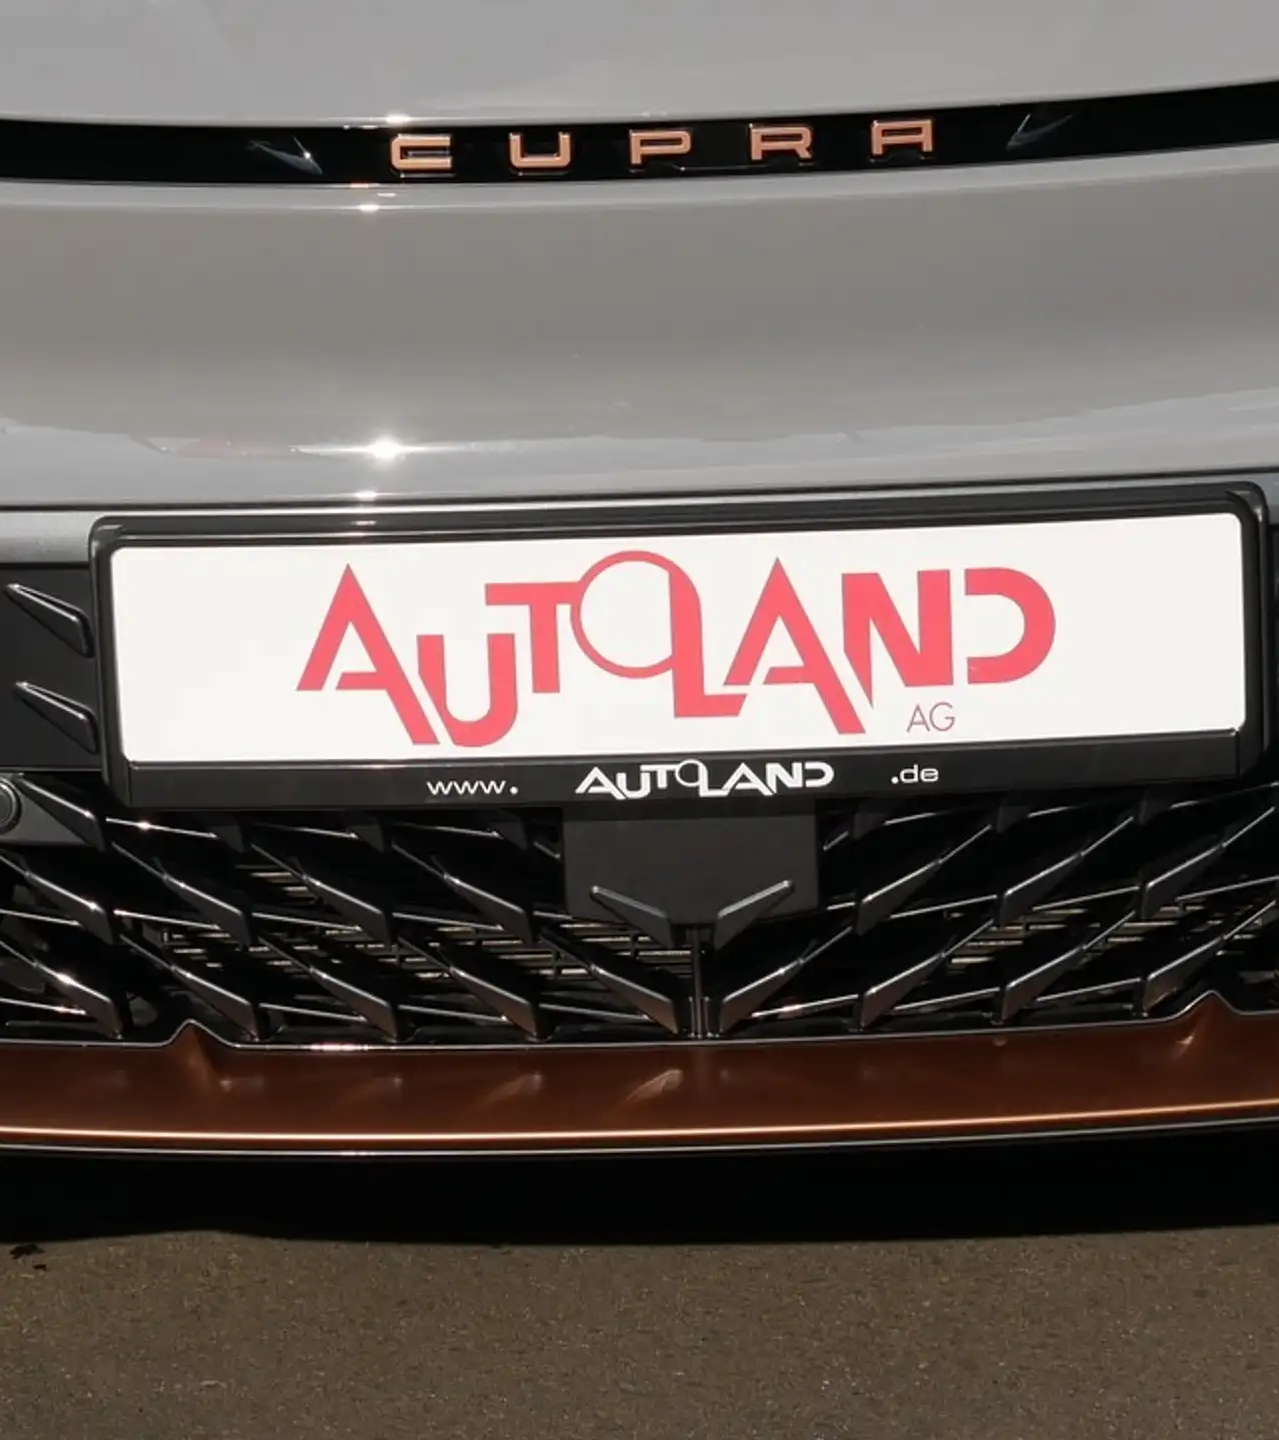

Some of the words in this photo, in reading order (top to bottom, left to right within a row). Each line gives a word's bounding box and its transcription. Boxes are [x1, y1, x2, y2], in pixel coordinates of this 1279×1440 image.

[390, 117, 933, 171] CUPRA
[296, 549, 1057, 748] AUTOLAND
[906, 701, 957, 733] AG
[426, 779, 519, 796] www.
[574, 759, 835, 801] AUTOLAND
[891, 763, 939, 785] .de
